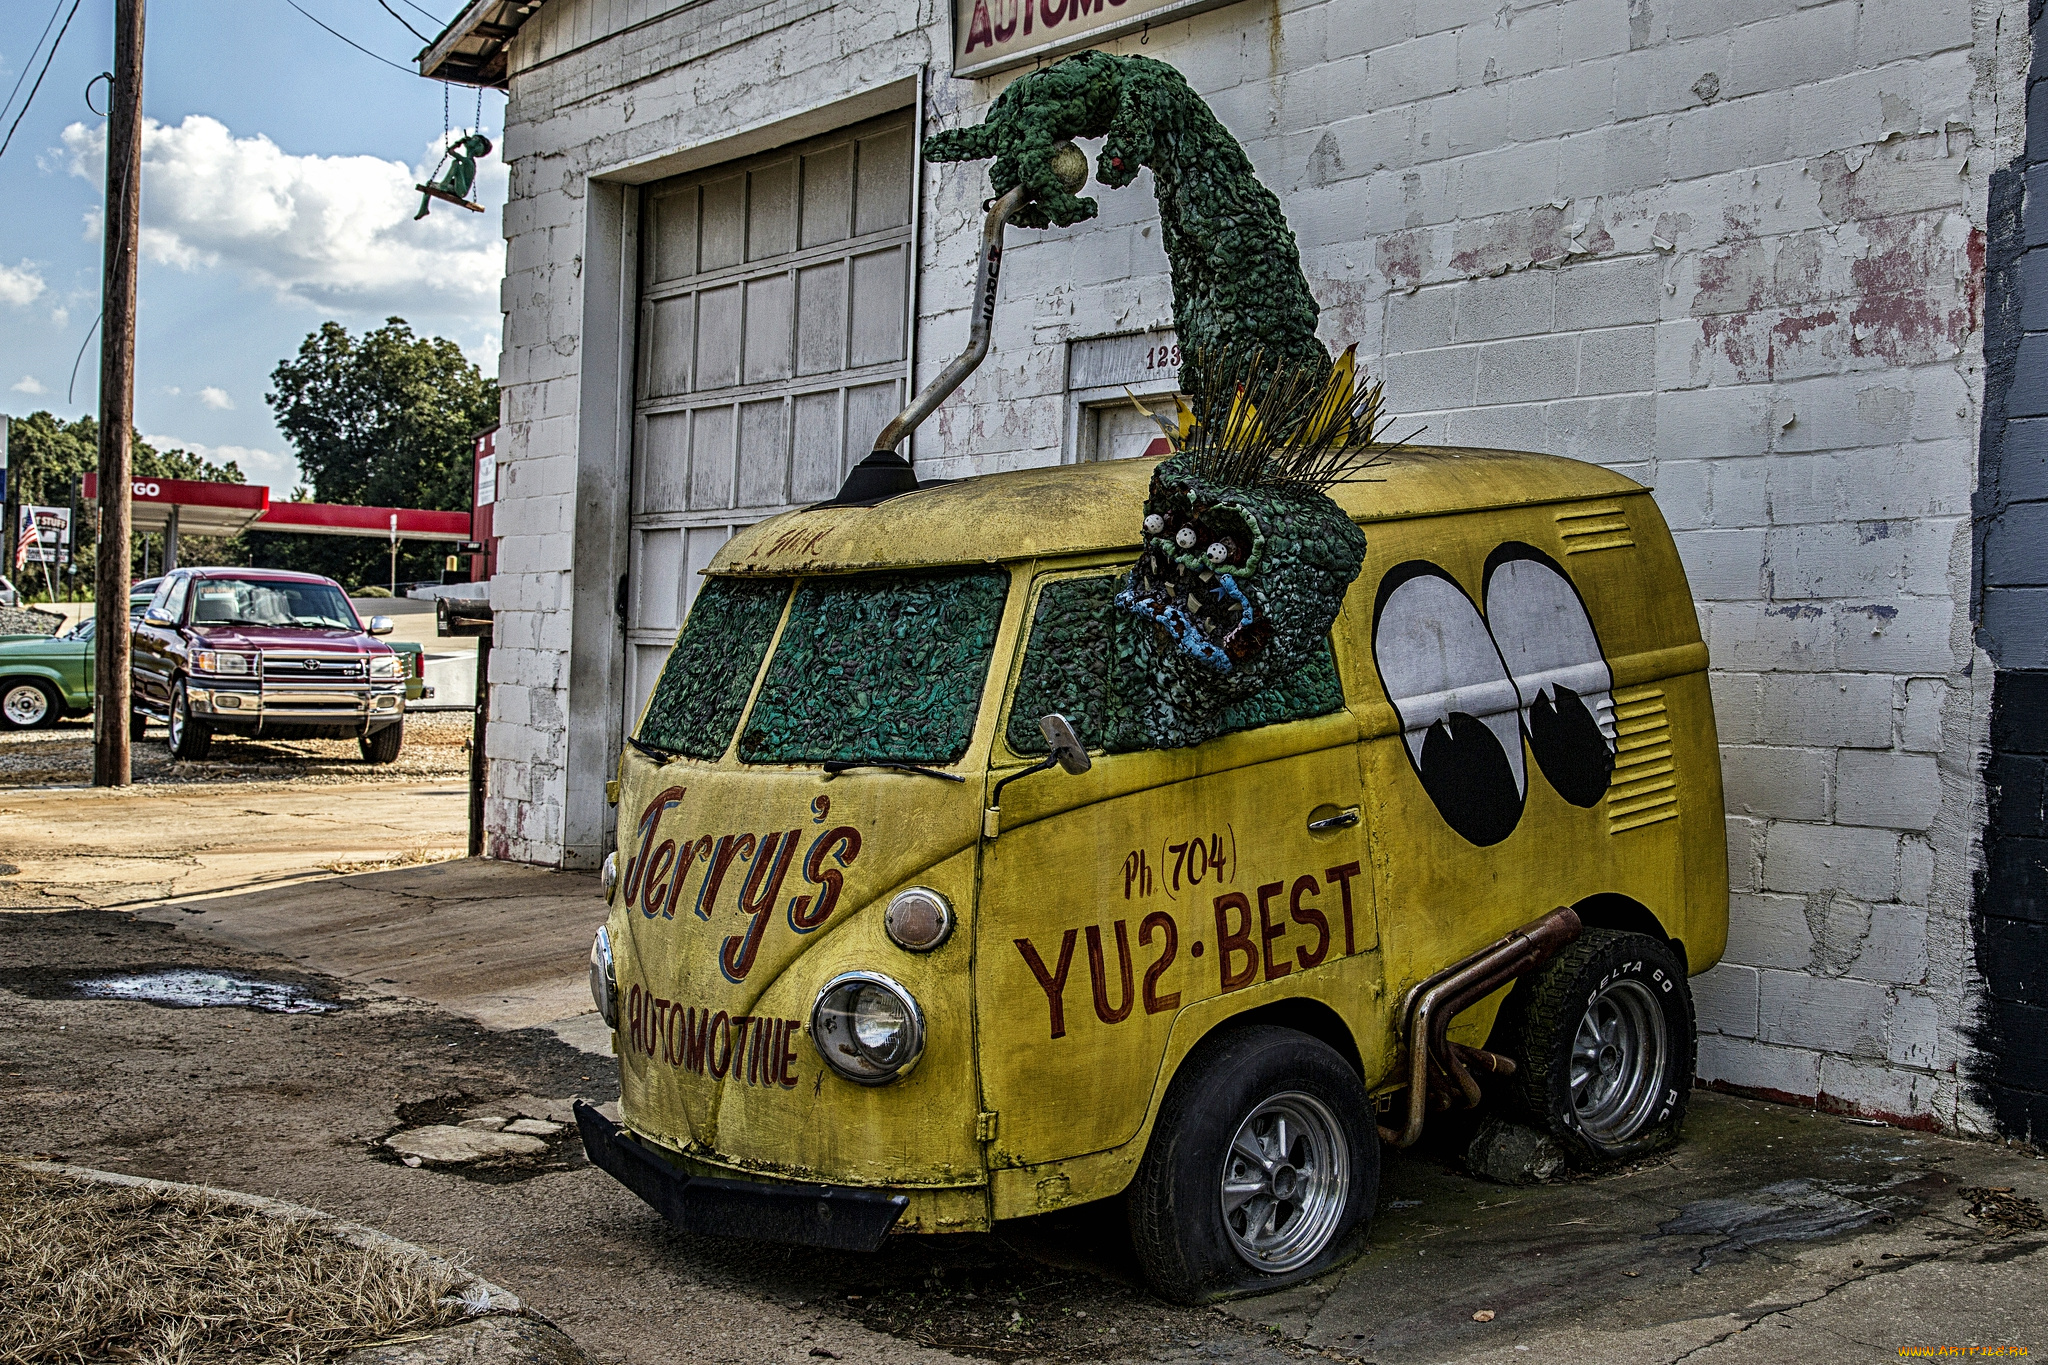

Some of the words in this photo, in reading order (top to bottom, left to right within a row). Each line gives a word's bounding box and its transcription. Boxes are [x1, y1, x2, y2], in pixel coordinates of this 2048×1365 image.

[964, 0, 1128, 54] AUTO
[1146, 344, 1181, 370] 123
[623, 785, 863, 985] Jerry's
[1161, 822, 1237, 901] (704)
[1587, 960, 1643, 1006] DELTA
[1652, 968, 1673, 993] 60
[628, 984, 801, 1089] AUTOMOTIVE
